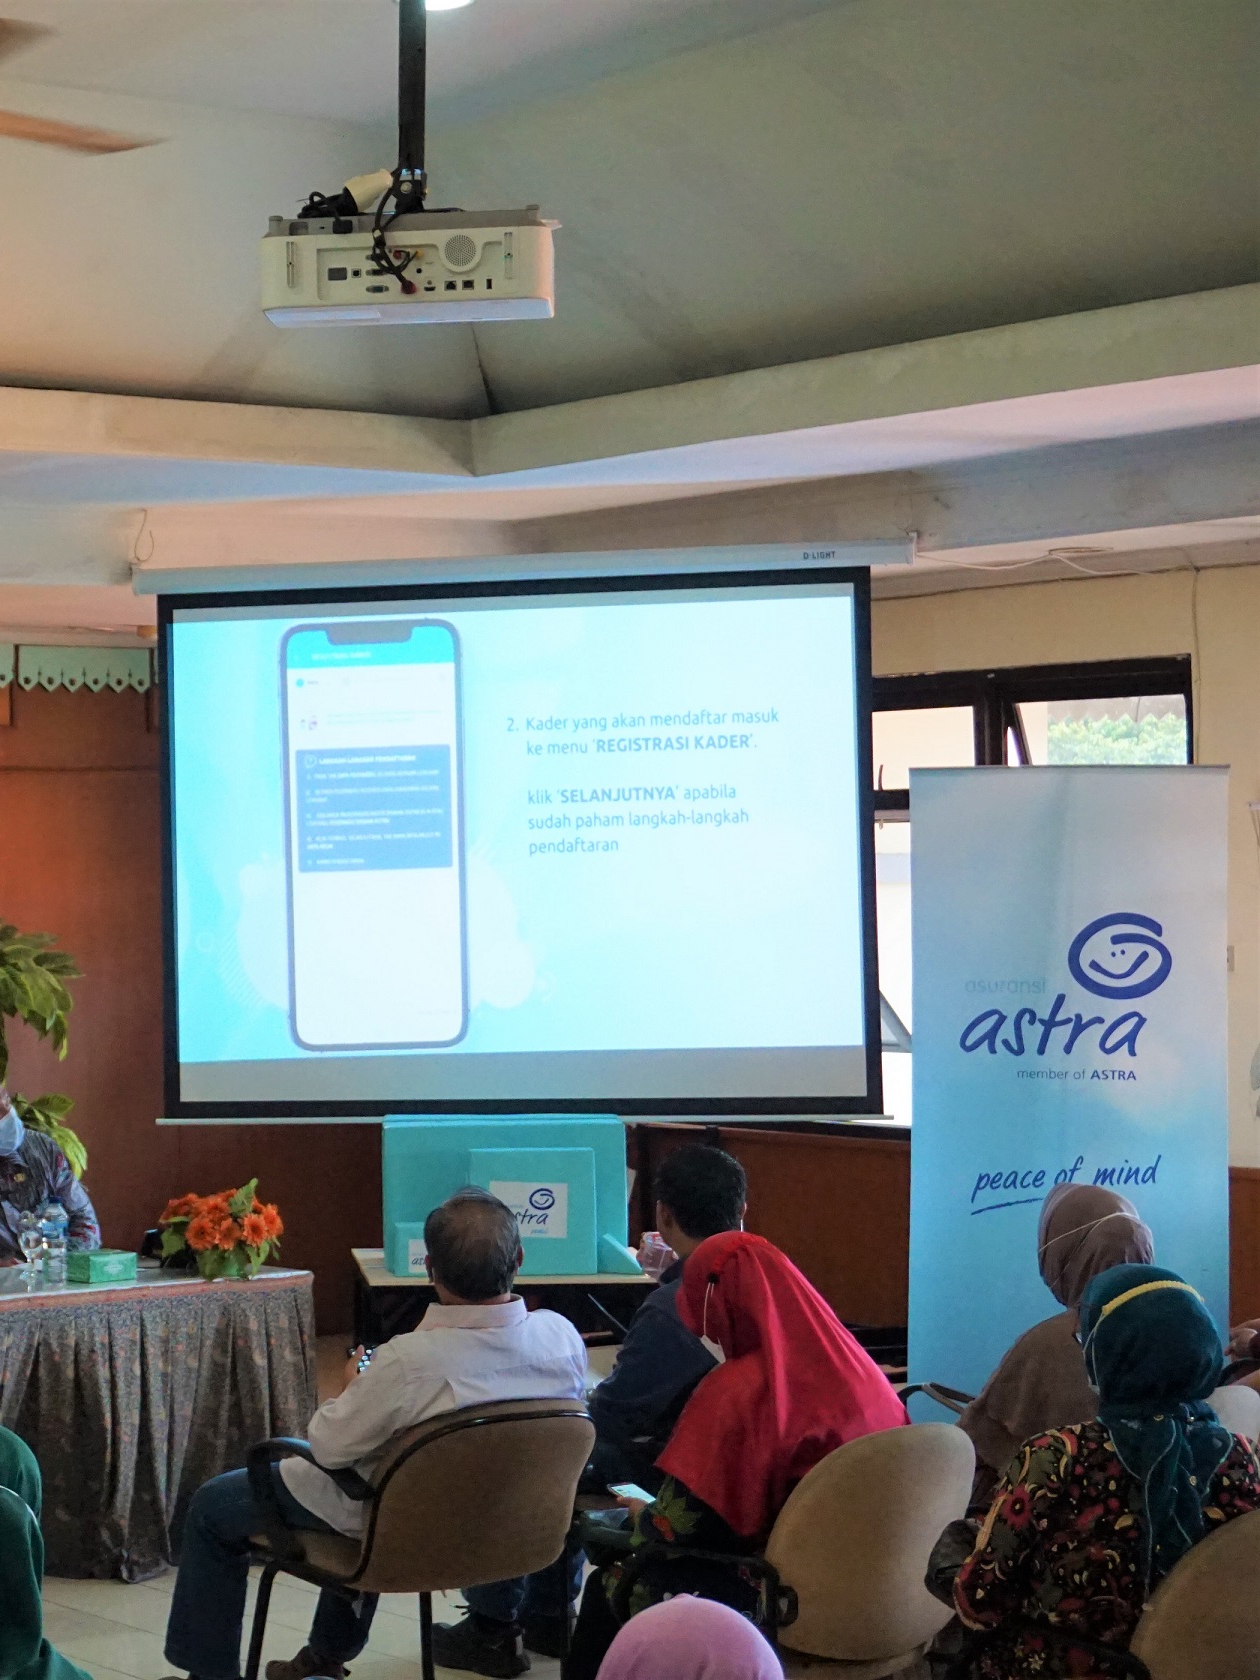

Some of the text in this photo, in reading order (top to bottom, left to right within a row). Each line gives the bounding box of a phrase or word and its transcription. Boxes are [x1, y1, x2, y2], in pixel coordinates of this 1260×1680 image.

[506, 707, 780, 733] 2. Kader yang akan mendaftar masuk
[526, 740, 544, 755] ke
[547, 741, 589, 754] menu
[527, 789, 553, 805] klik
[682, 783, 737, 802] apabila
[528, 808, 750, 830] sudah paham langkah-langkah
[528, 837, 620, 857] pendaftaran
[964, 976, 1048, 994] asuransi
[959, 993, 1148, 1057] astra
[1016, 1068, 1137, 1081] member of ASTRA
[970, 1154, 1162, 1204] peace of mind
